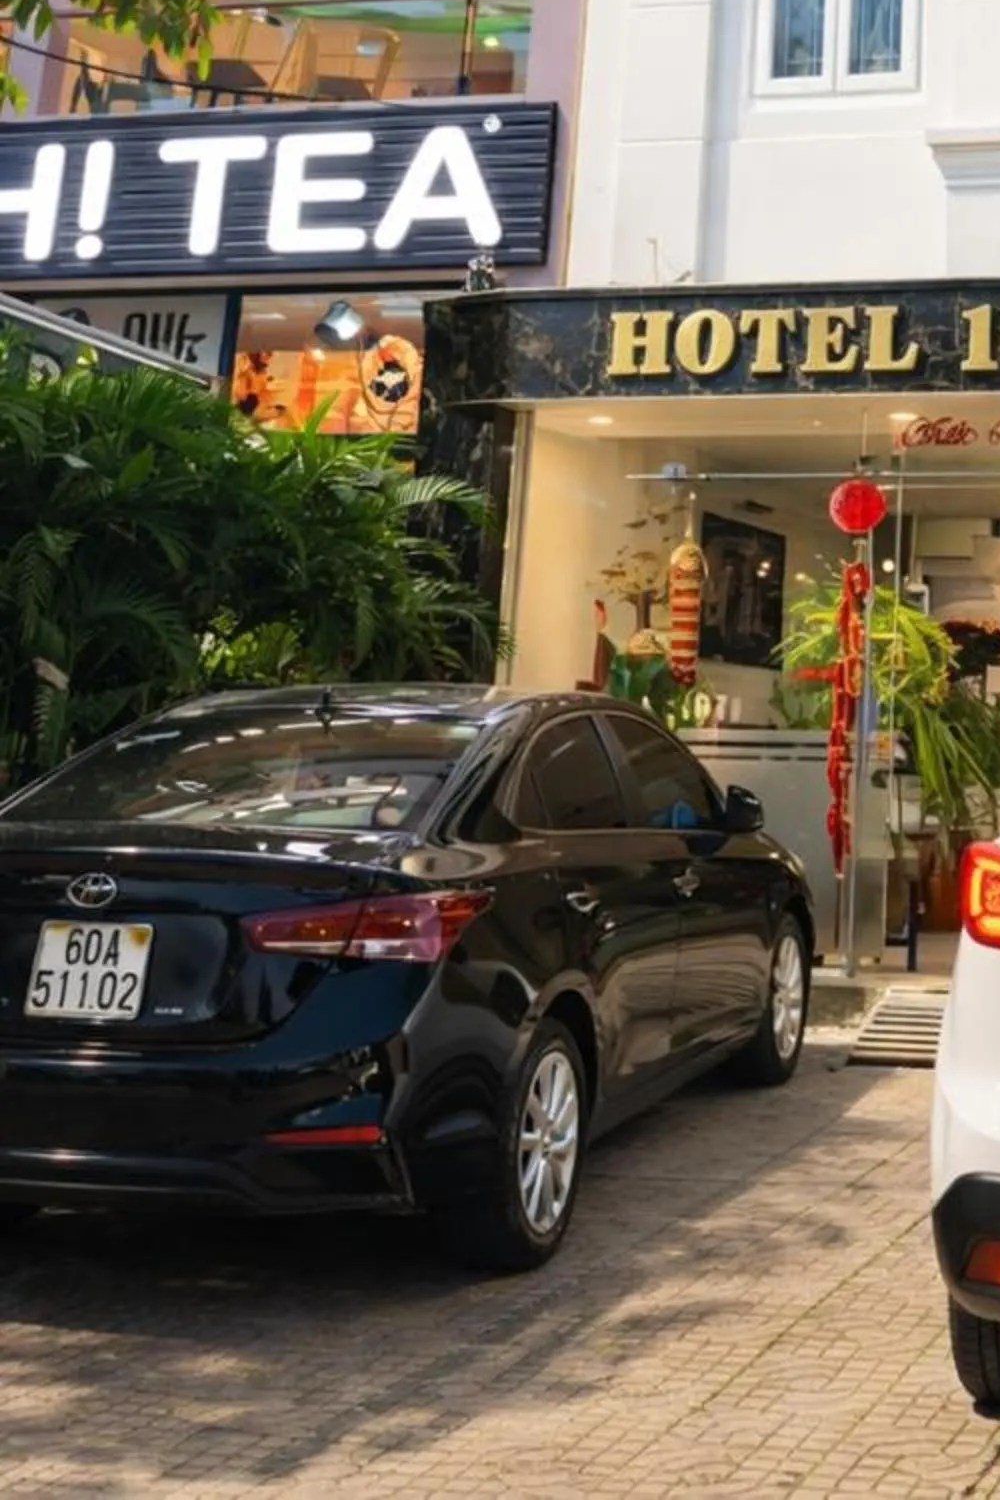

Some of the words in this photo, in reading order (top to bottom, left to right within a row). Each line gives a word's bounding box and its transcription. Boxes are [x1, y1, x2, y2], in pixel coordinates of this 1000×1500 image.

[158, 125, 503, 257] TEA
[606, 306, 920, 376] HOTEL
[65, 928, 121, 968] 60A
